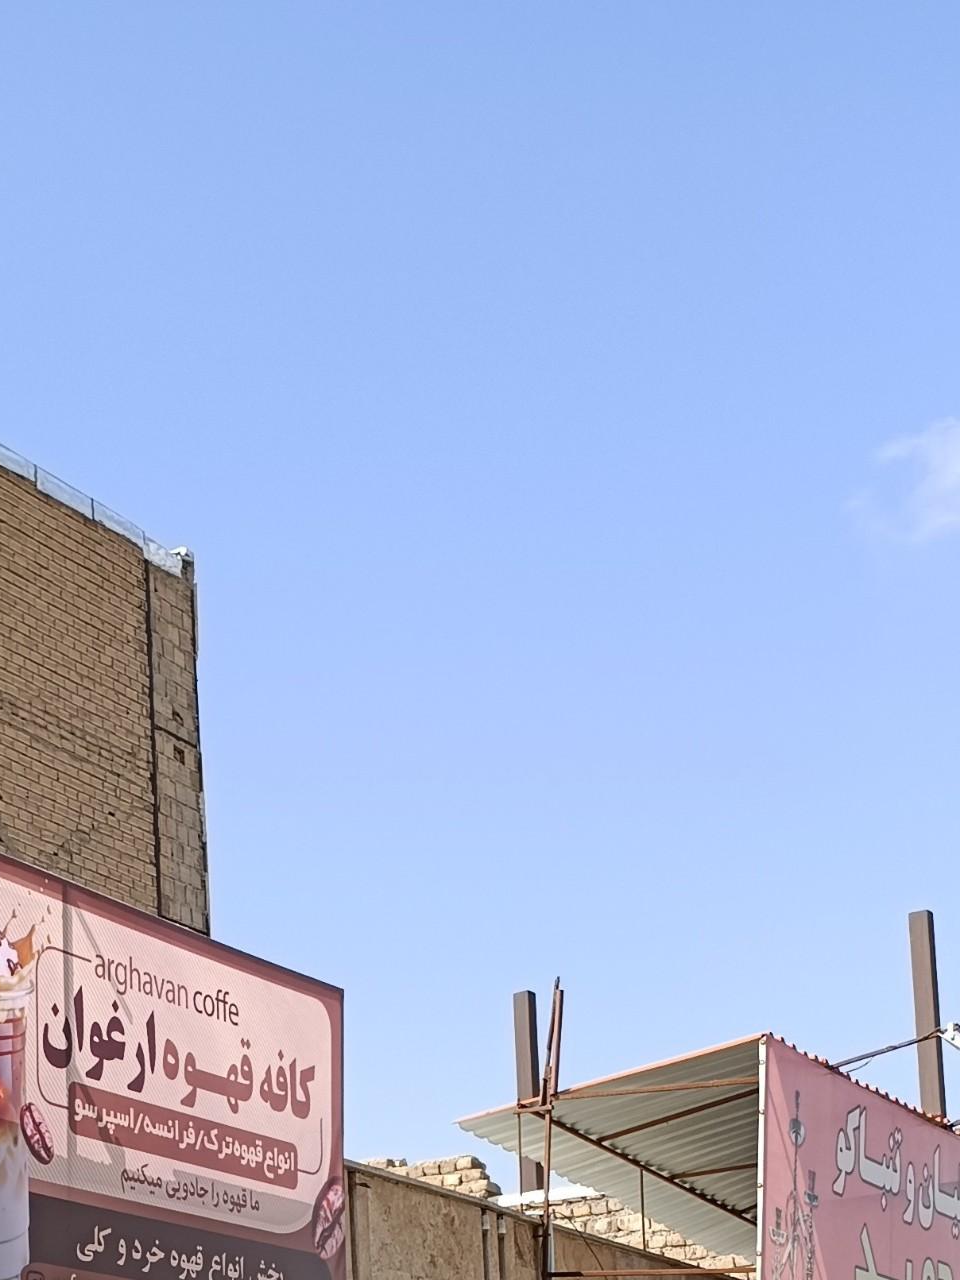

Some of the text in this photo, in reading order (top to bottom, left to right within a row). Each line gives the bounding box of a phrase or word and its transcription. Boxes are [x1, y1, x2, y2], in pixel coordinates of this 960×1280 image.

[94, 954, 239, 1026] arghavan coffe
[42, 985, 315, 1119] کافه قهوه ارغوان
[233, 1140, 263, 1168] قهوه
[263, 1147, 295, 1179] انواع
[832, 1104, 960, 1239] یان و تنباکو
[120, 1163, 260, 1213] ما قهوه را جادویی میکنیم
[76, 1225, 112, 1261] کلی
[117, 1237, 127, 1266] و
[132, 1239, 165, 1272] خرد
[170, 1245, 204, 1279] قهوه
